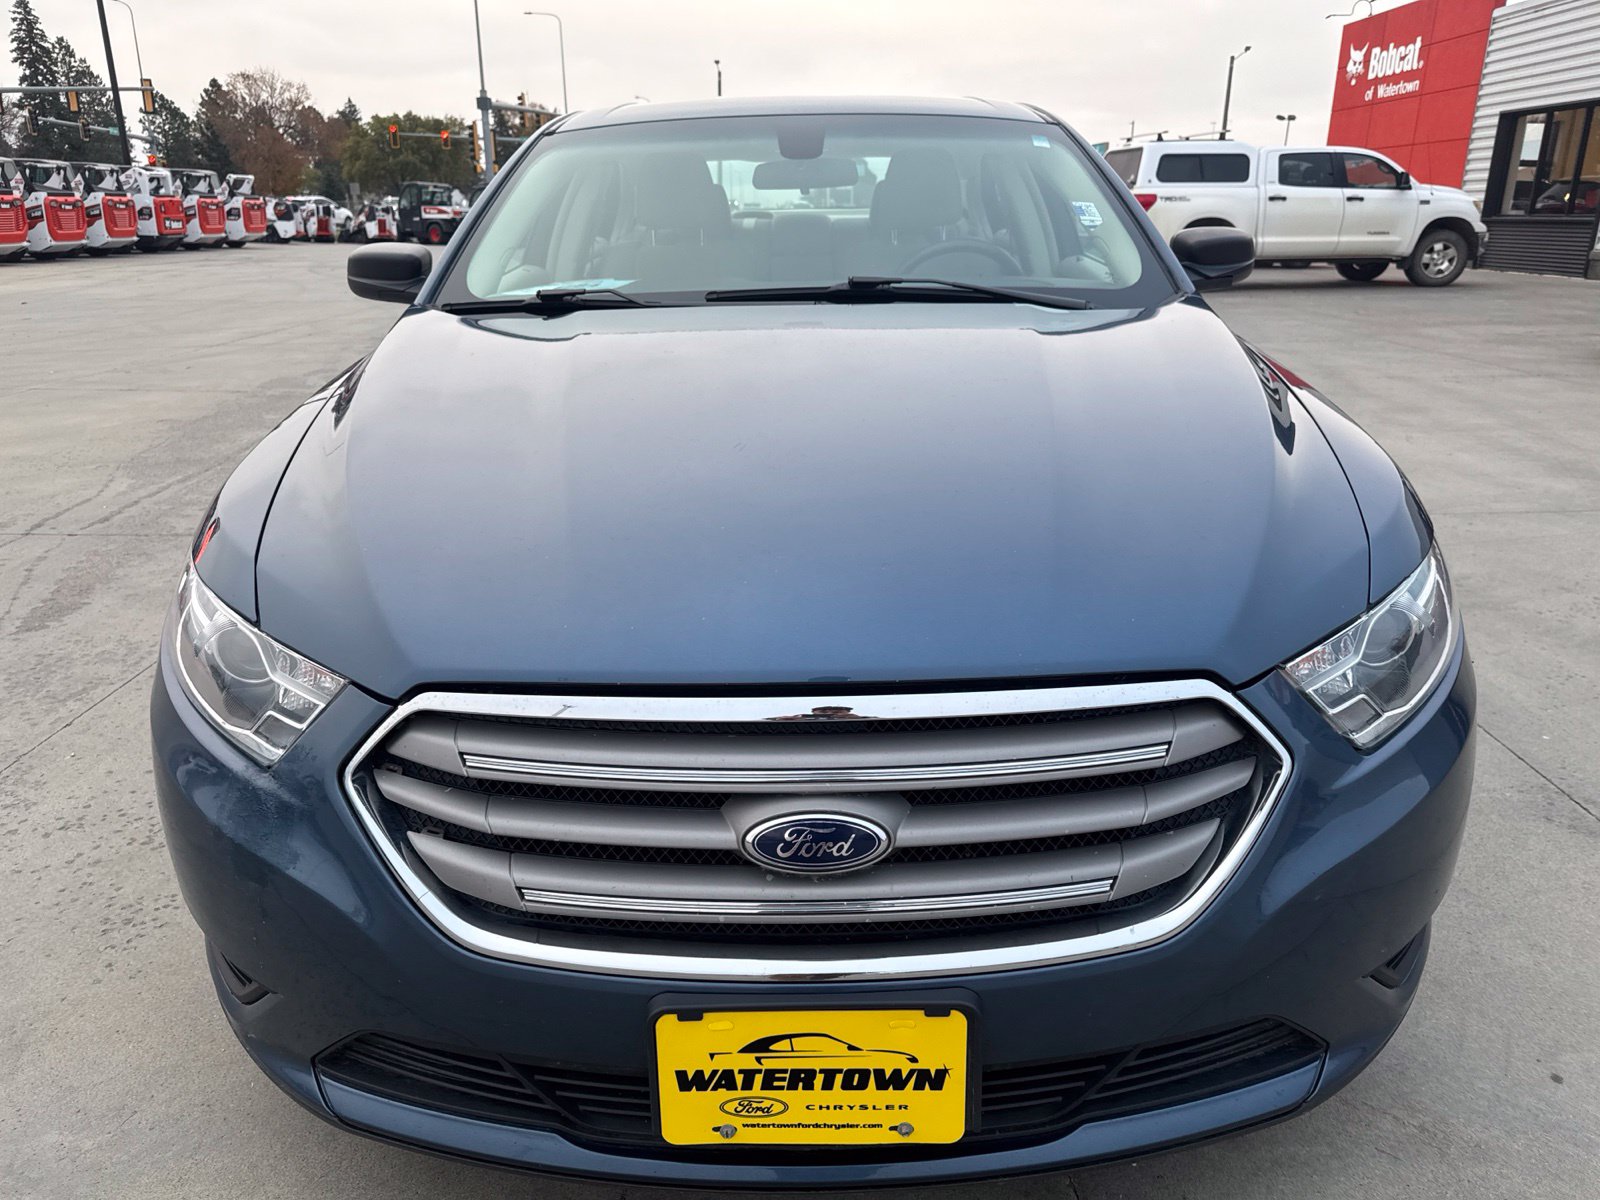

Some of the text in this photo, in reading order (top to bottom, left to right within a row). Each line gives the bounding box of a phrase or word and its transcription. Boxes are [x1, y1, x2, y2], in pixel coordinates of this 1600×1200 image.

[1364, 80, 1420, 102] of Watertown
[776, 826, 856, 858] Ford
[674, 1068, 950, 1092] WATERTOWN
[733, 1099, 774, 1115] Ford
[741, 1121, 883, 1130] watertownfordchrysler.com
